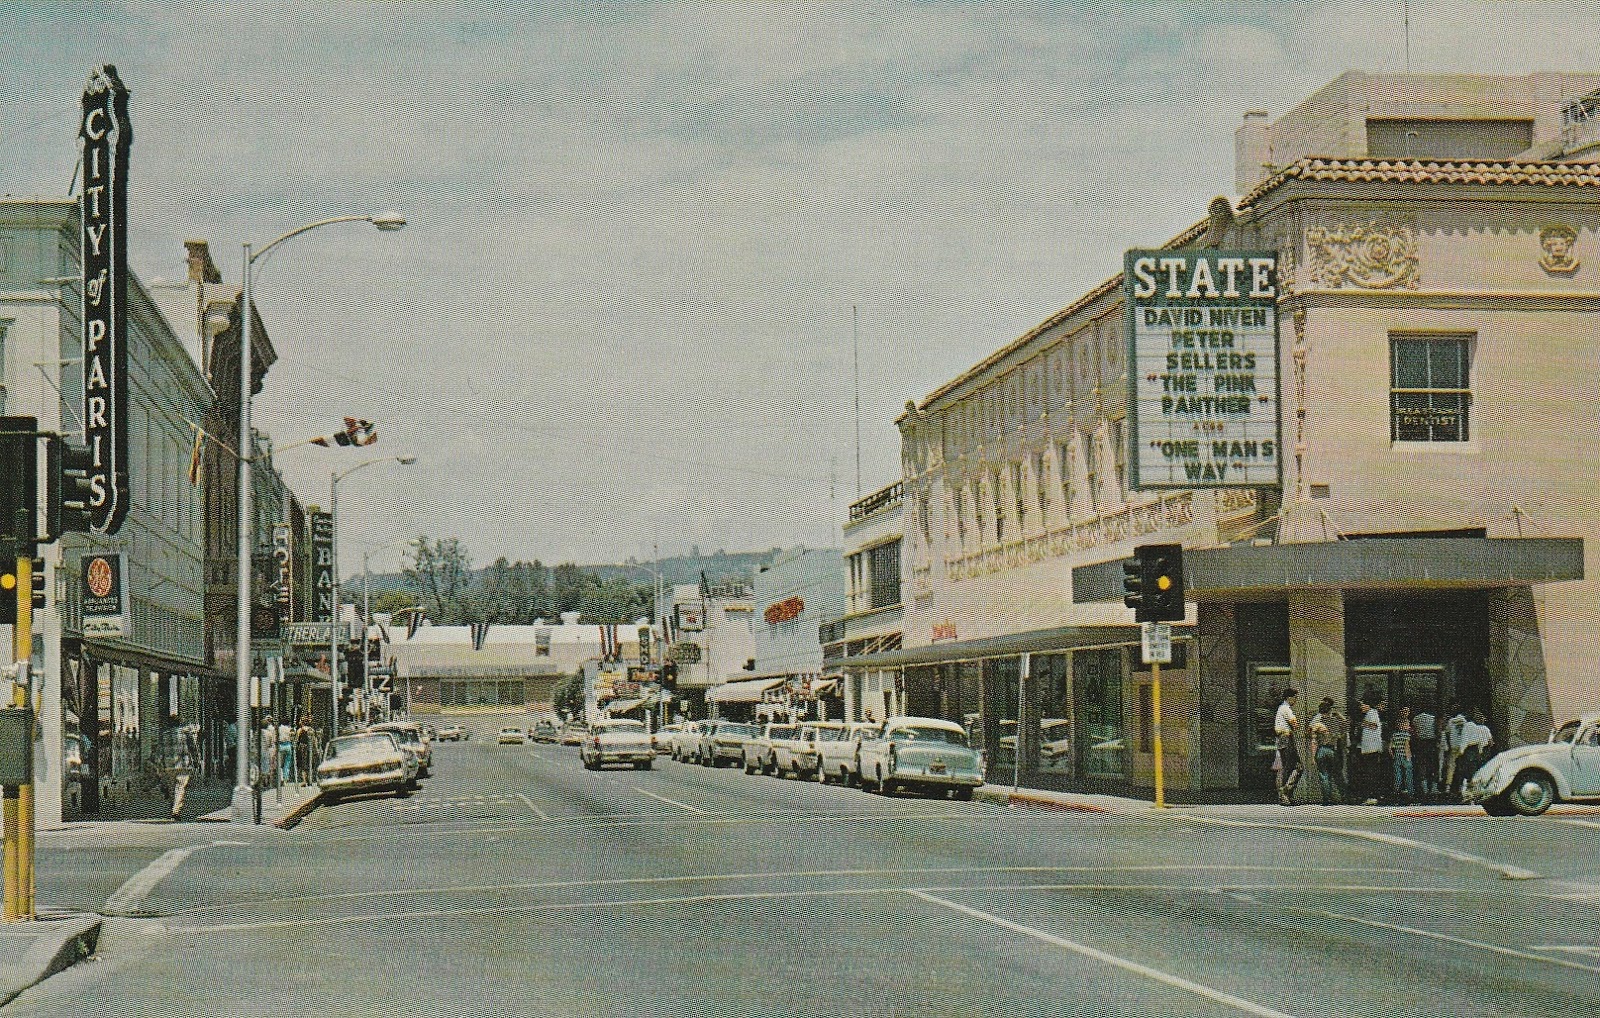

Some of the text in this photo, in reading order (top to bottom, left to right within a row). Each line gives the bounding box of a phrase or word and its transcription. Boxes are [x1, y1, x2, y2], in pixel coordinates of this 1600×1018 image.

[1134, 257, 1275, 298] STATE
[85, 108, 108, 507] CITY of PARIS
[1144, 308, 1267, 326] DAVID NIVEN
[1171, 330, 1235, 348] PETER
[1166, 352, 1256, 370] SELLERS
[1214, 373, 1256, 392] PINK
